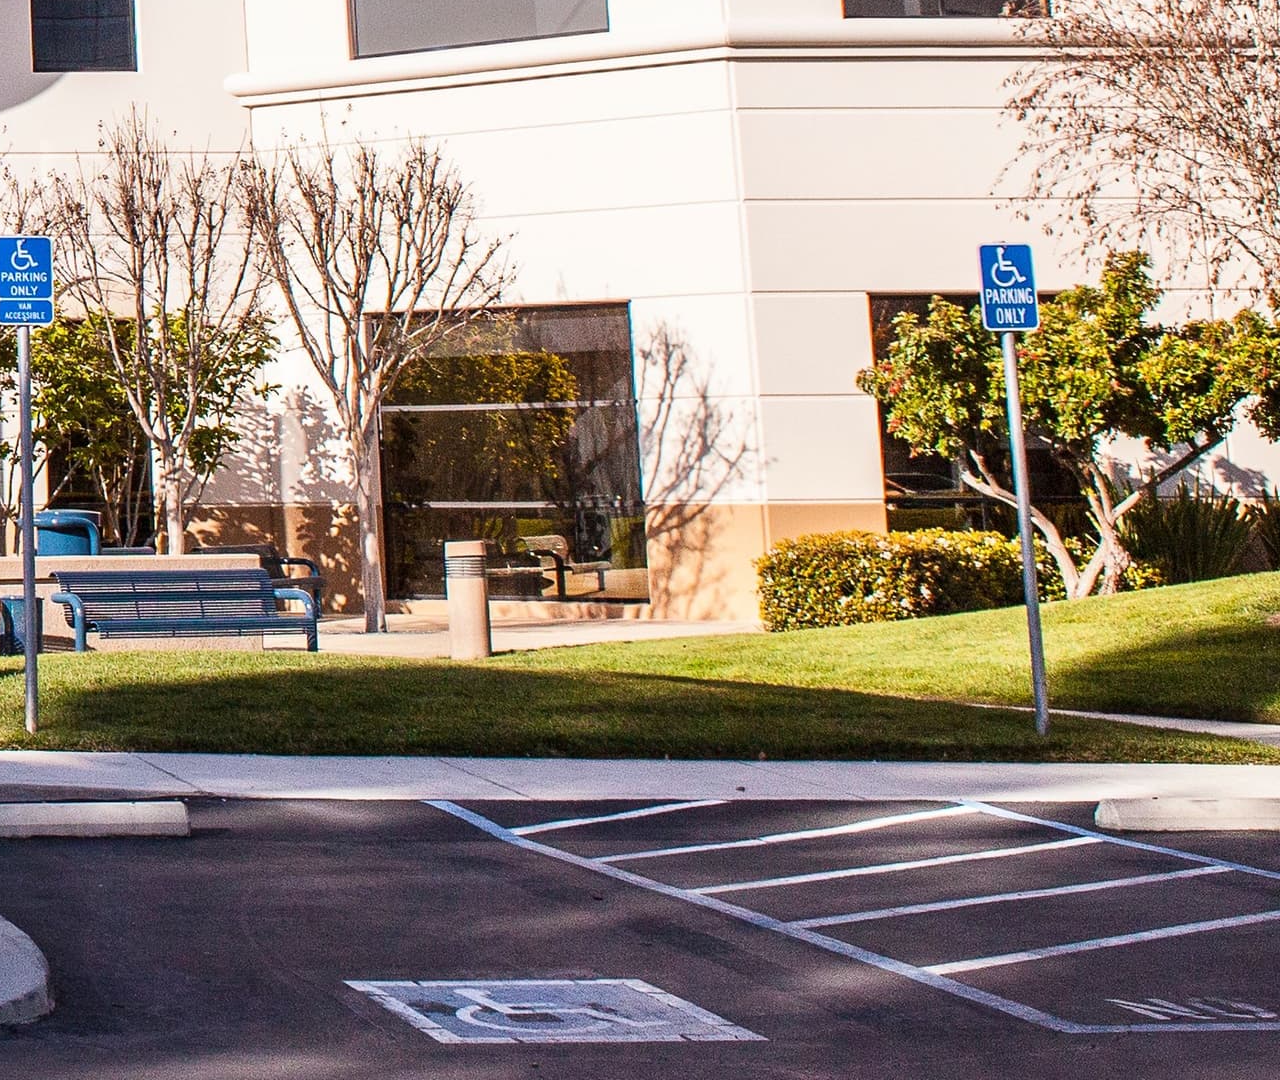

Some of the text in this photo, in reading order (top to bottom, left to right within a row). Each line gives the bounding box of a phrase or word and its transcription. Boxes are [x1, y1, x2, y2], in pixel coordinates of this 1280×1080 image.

[1, 272, 48, 282] PARKING
[10, 285, 38, 296] ONLY
[985, 288, 1034, 305] PARKING
[4, 311, 46, 320] ACCESSIBLE
[996, 308, 1026, 324] ONLY
